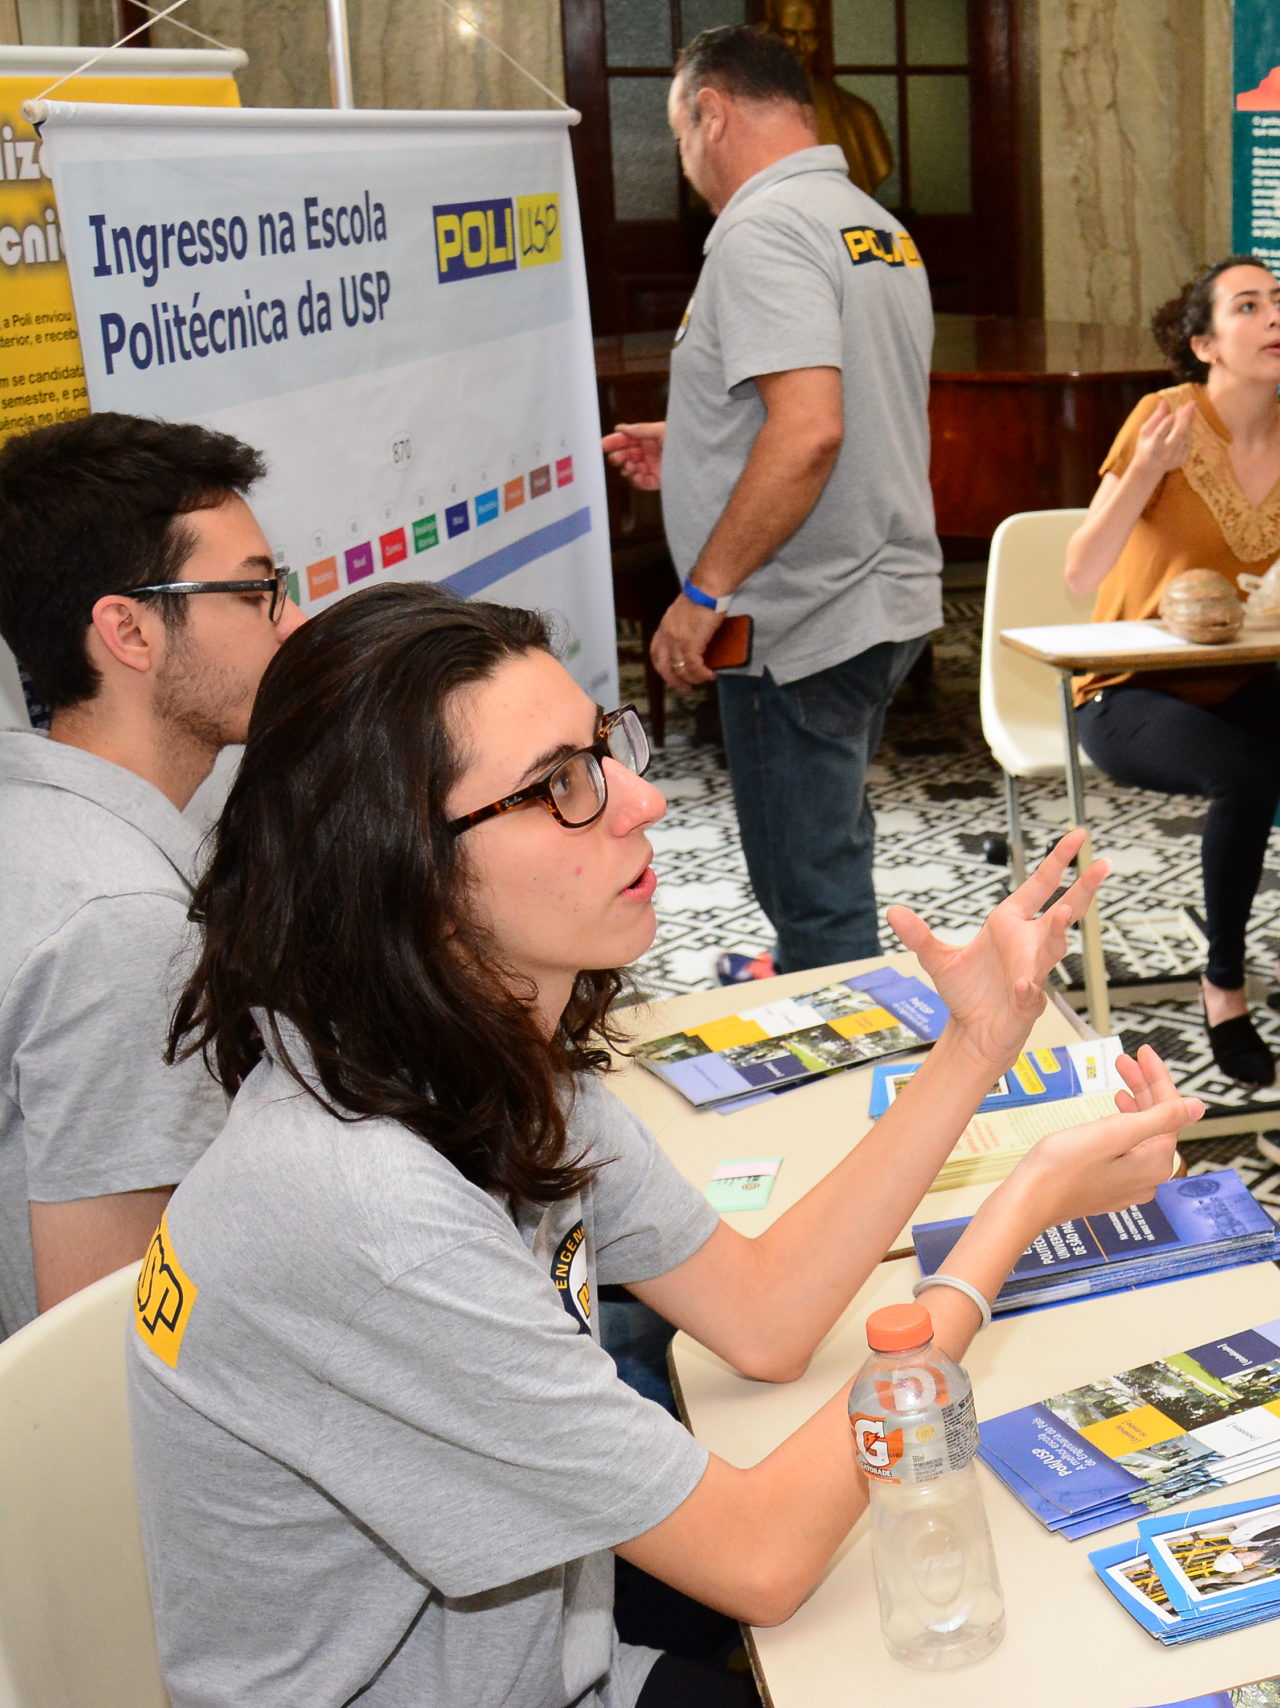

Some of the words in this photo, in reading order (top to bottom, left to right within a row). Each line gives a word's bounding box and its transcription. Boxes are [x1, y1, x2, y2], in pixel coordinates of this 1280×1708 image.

[89, 214, 248, 287] Ingresso
[258, 210, 295, 256] na
[304, 190, 387, 249] Escola
[436, 208, 513, 273] POLI
[35, 310, 71, 324] enviou
[100, 289, 288, 375] Politécnica
[298, 280, 331, 336] da
[340, 271, 391, 327] USP
[12, 375, 25, 387] se
[1066, 1233, 1083, 1246] SÃO
[1073, 1245, 1087, 1255] DE
[555, 1227, 586, 1290] ENGEN
[1045, 1426, 1056, 1434] do
[1038, 1432, 1059, 1448] escola
[1053, 1432, 1088, 1461] Engenharia
[1031, 1448, 1072, 1477] Poli/USP
[1056, 1449, 1080, 1466] melhor
[1084, 1459, 1097, 1467] de
